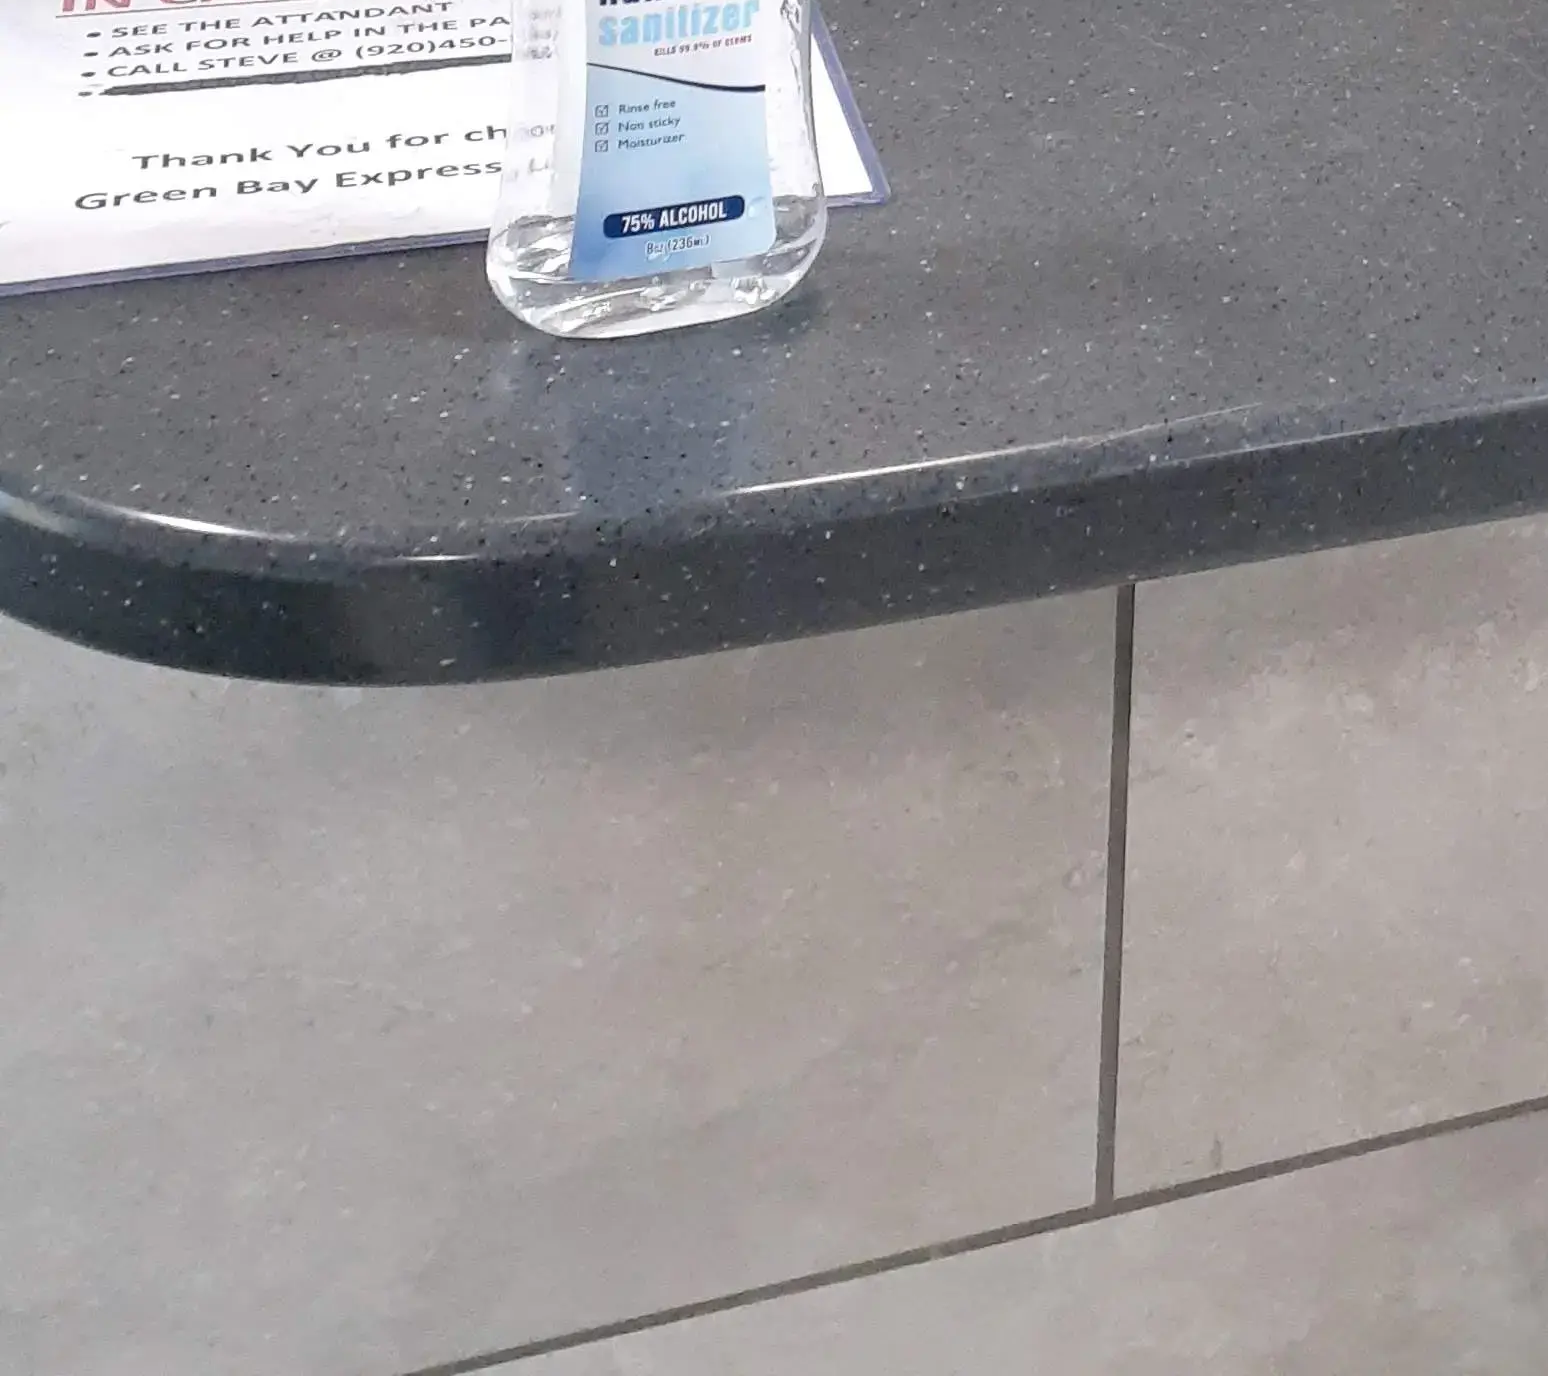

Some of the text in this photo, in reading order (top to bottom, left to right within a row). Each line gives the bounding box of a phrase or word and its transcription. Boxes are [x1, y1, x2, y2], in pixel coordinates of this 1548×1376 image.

[111, 0, 455, 39] SEE THE ATTANDANT
[107, 41, 175, 58] ASK
[185, 36, 252, 52] FOR
[262, 28, 343, 46] HELP
[353, 25, 387, 39] IN
[396, 19, 459, 35] THE
[106, 60, 189, 78] CALL
[197, 51, 299, 71] STEVE
[311, 48, 342, 62] @
[618, 98, 677, 115] Rinse free
[617, 115, 681, 133] Non sticky
[617, 132, 686, 150] Moisturizer
[131, 146, 274, 171] Thank
[285, 141, 371, 159] You
[385, 132, 450, 150] for
[74, 184, 219, 211] Green
[235, 177, 319, 195] Bay
[335, 159, 503, 188] Express
[621, 200, 728, 234] 75% ALCOHOL
